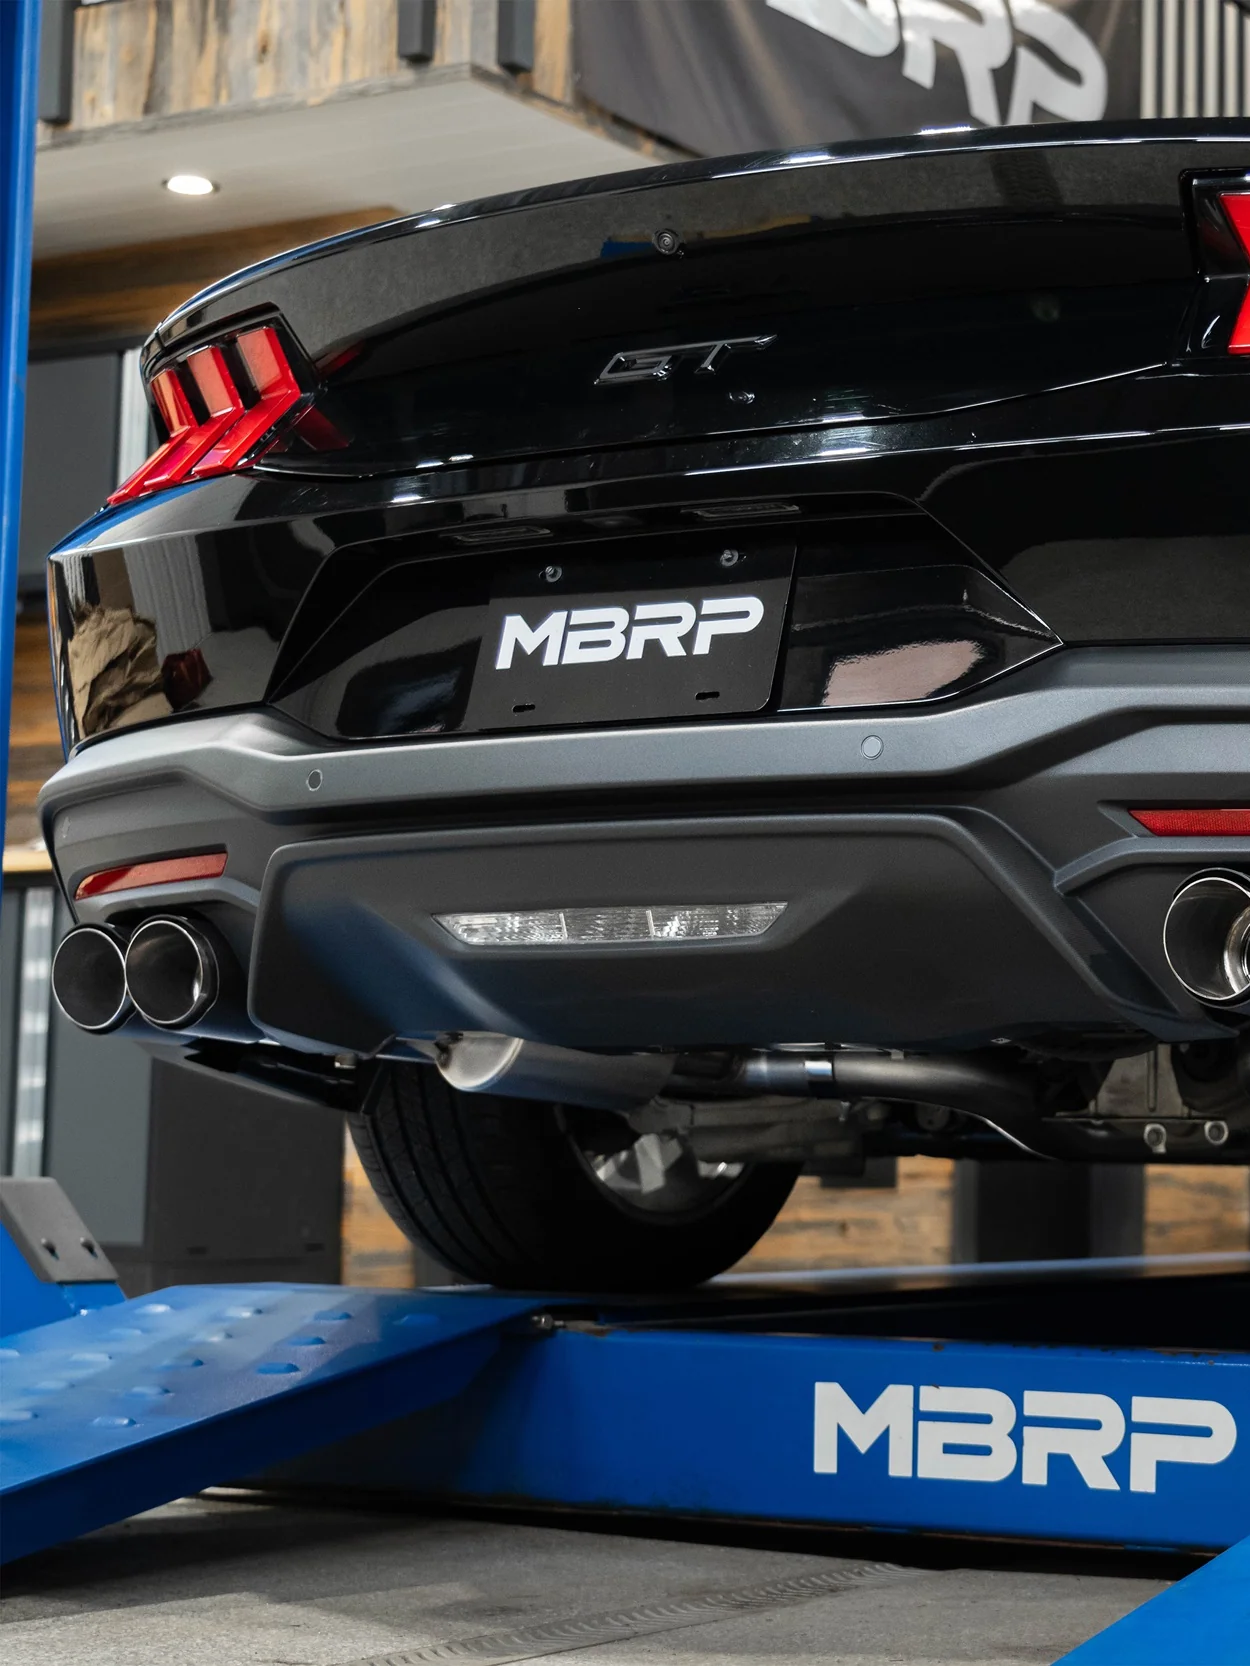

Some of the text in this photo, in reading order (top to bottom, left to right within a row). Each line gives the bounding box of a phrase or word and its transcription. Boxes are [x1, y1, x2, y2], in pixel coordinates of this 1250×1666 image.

[594, 334, 778, 386] GT
[495, 596, 765, 670] MBRP
[813, 1381, 1238, 1494] MBRP
